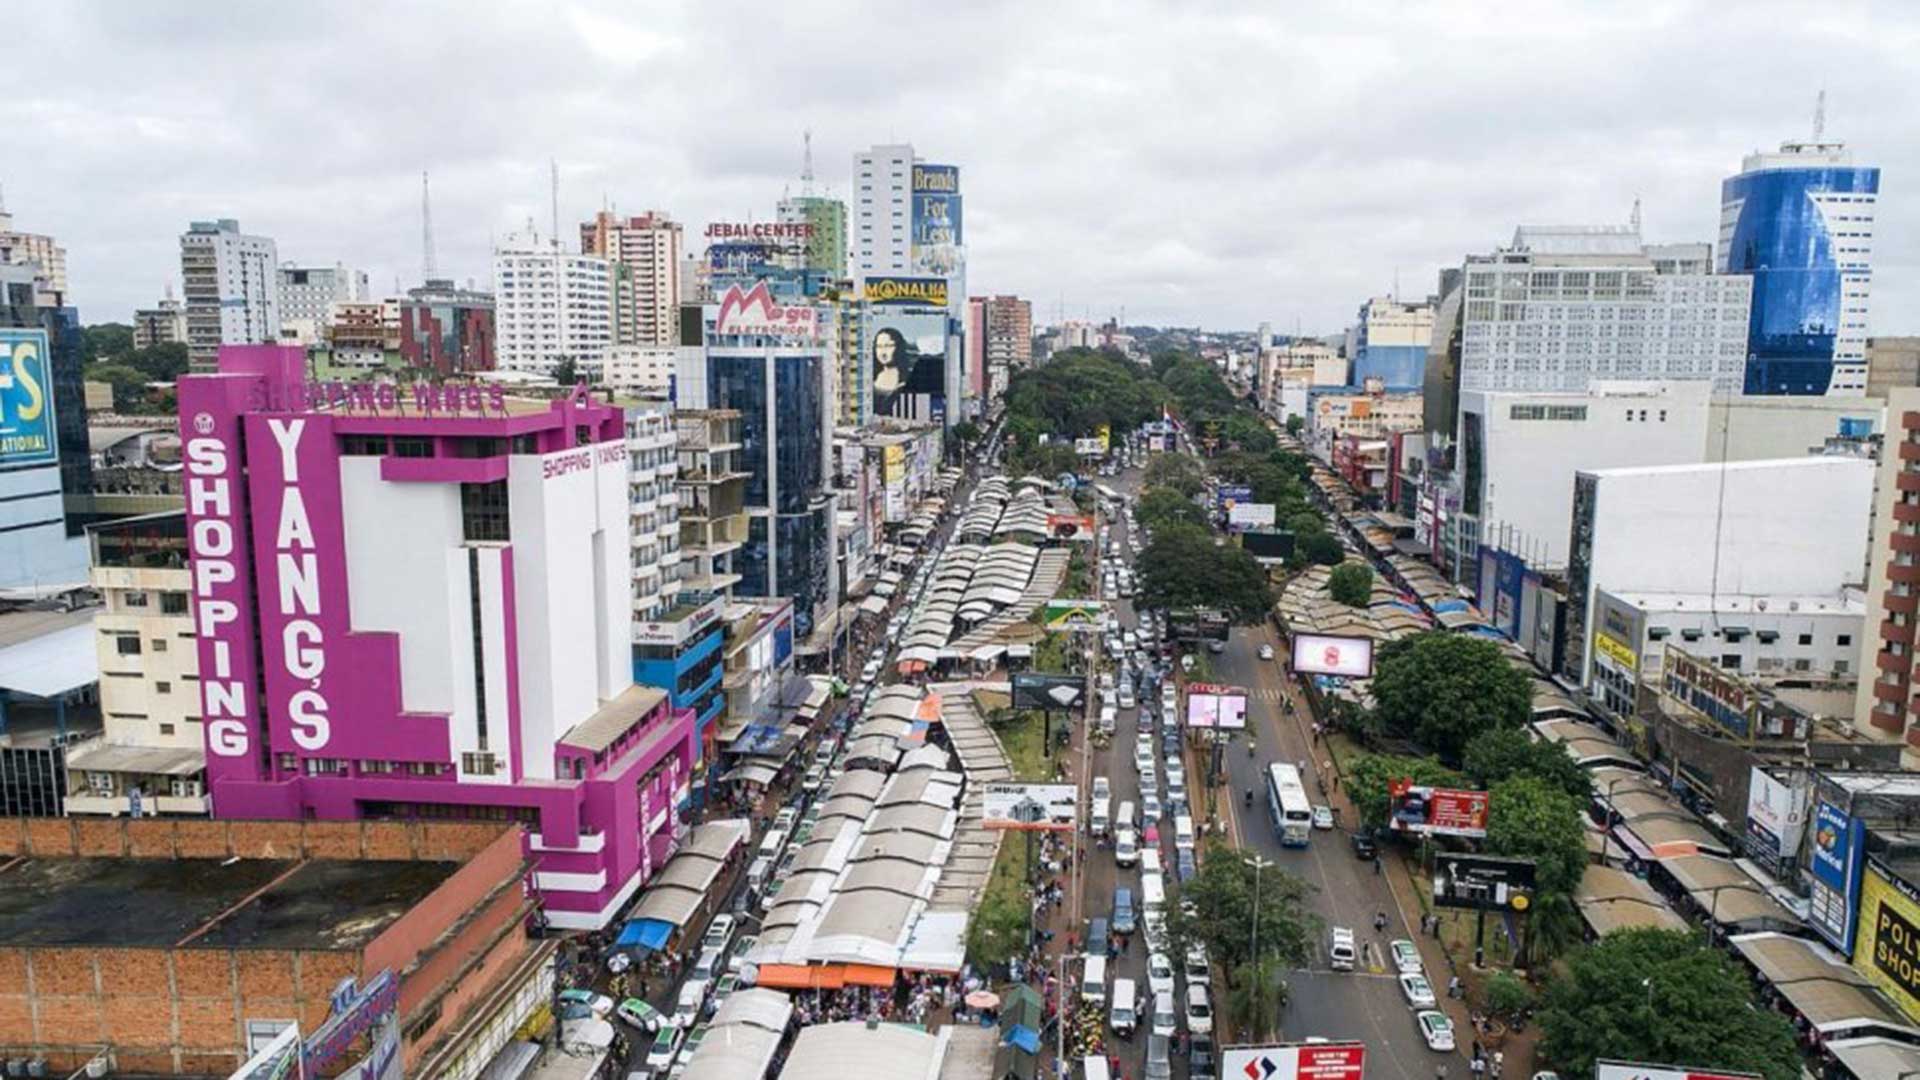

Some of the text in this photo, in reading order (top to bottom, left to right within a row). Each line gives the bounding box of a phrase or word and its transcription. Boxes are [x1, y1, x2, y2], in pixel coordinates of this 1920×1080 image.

[923, 198, 949, 218] For
[704, 223, 815, 238] JEBAI CENTER
[543, 451, 591, 479] SHOPPING
[187, 438, 249, 757] SHOPPING
[267, 419, 331, 750] YANG'S
